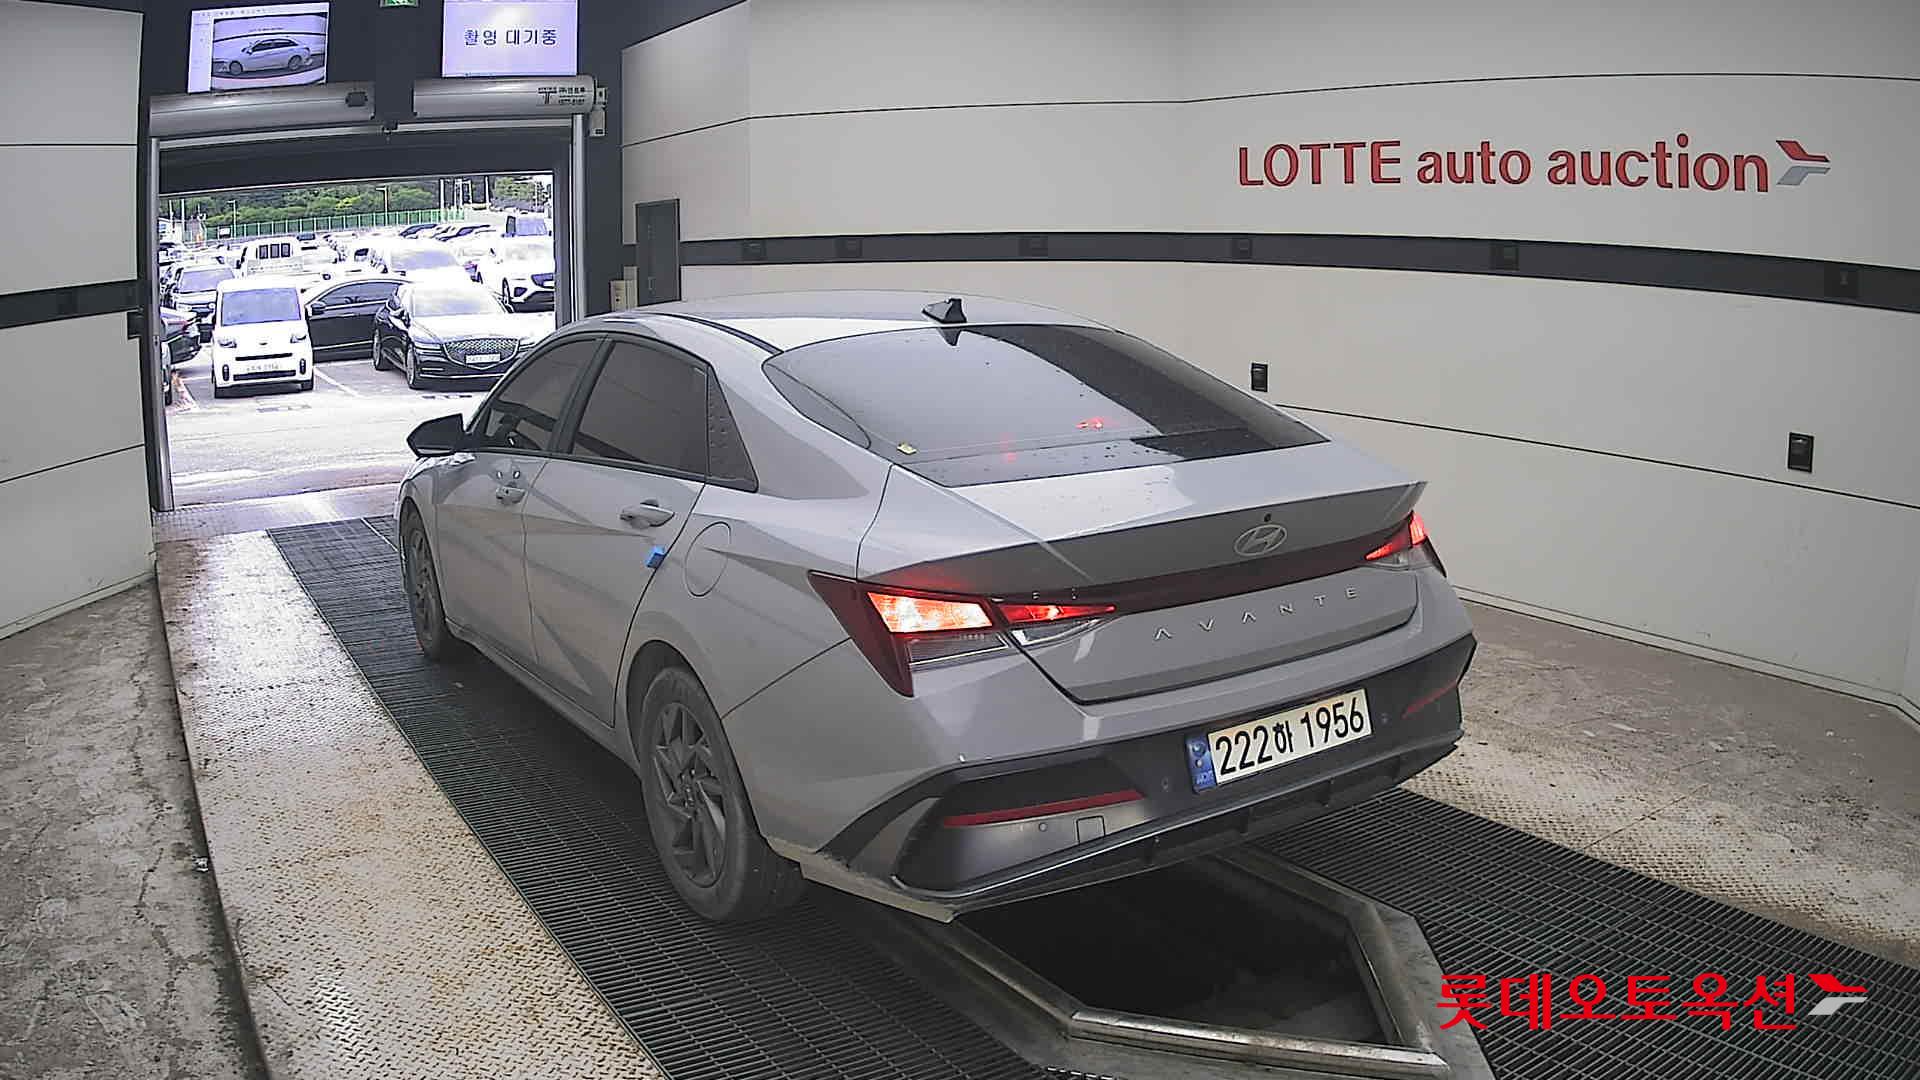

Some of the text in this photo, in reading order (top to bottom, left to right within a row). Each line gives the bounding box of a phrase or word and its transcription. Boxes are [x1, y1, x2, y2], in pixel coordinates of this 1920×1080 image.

[505, 29, 557, 46] 대기중
[1239, 133, 1770, 194] LOTTE auto auction
[1154, 587, 1358, 641] AVANTE
[1215, 697, 1365, 775] 222하 1956
